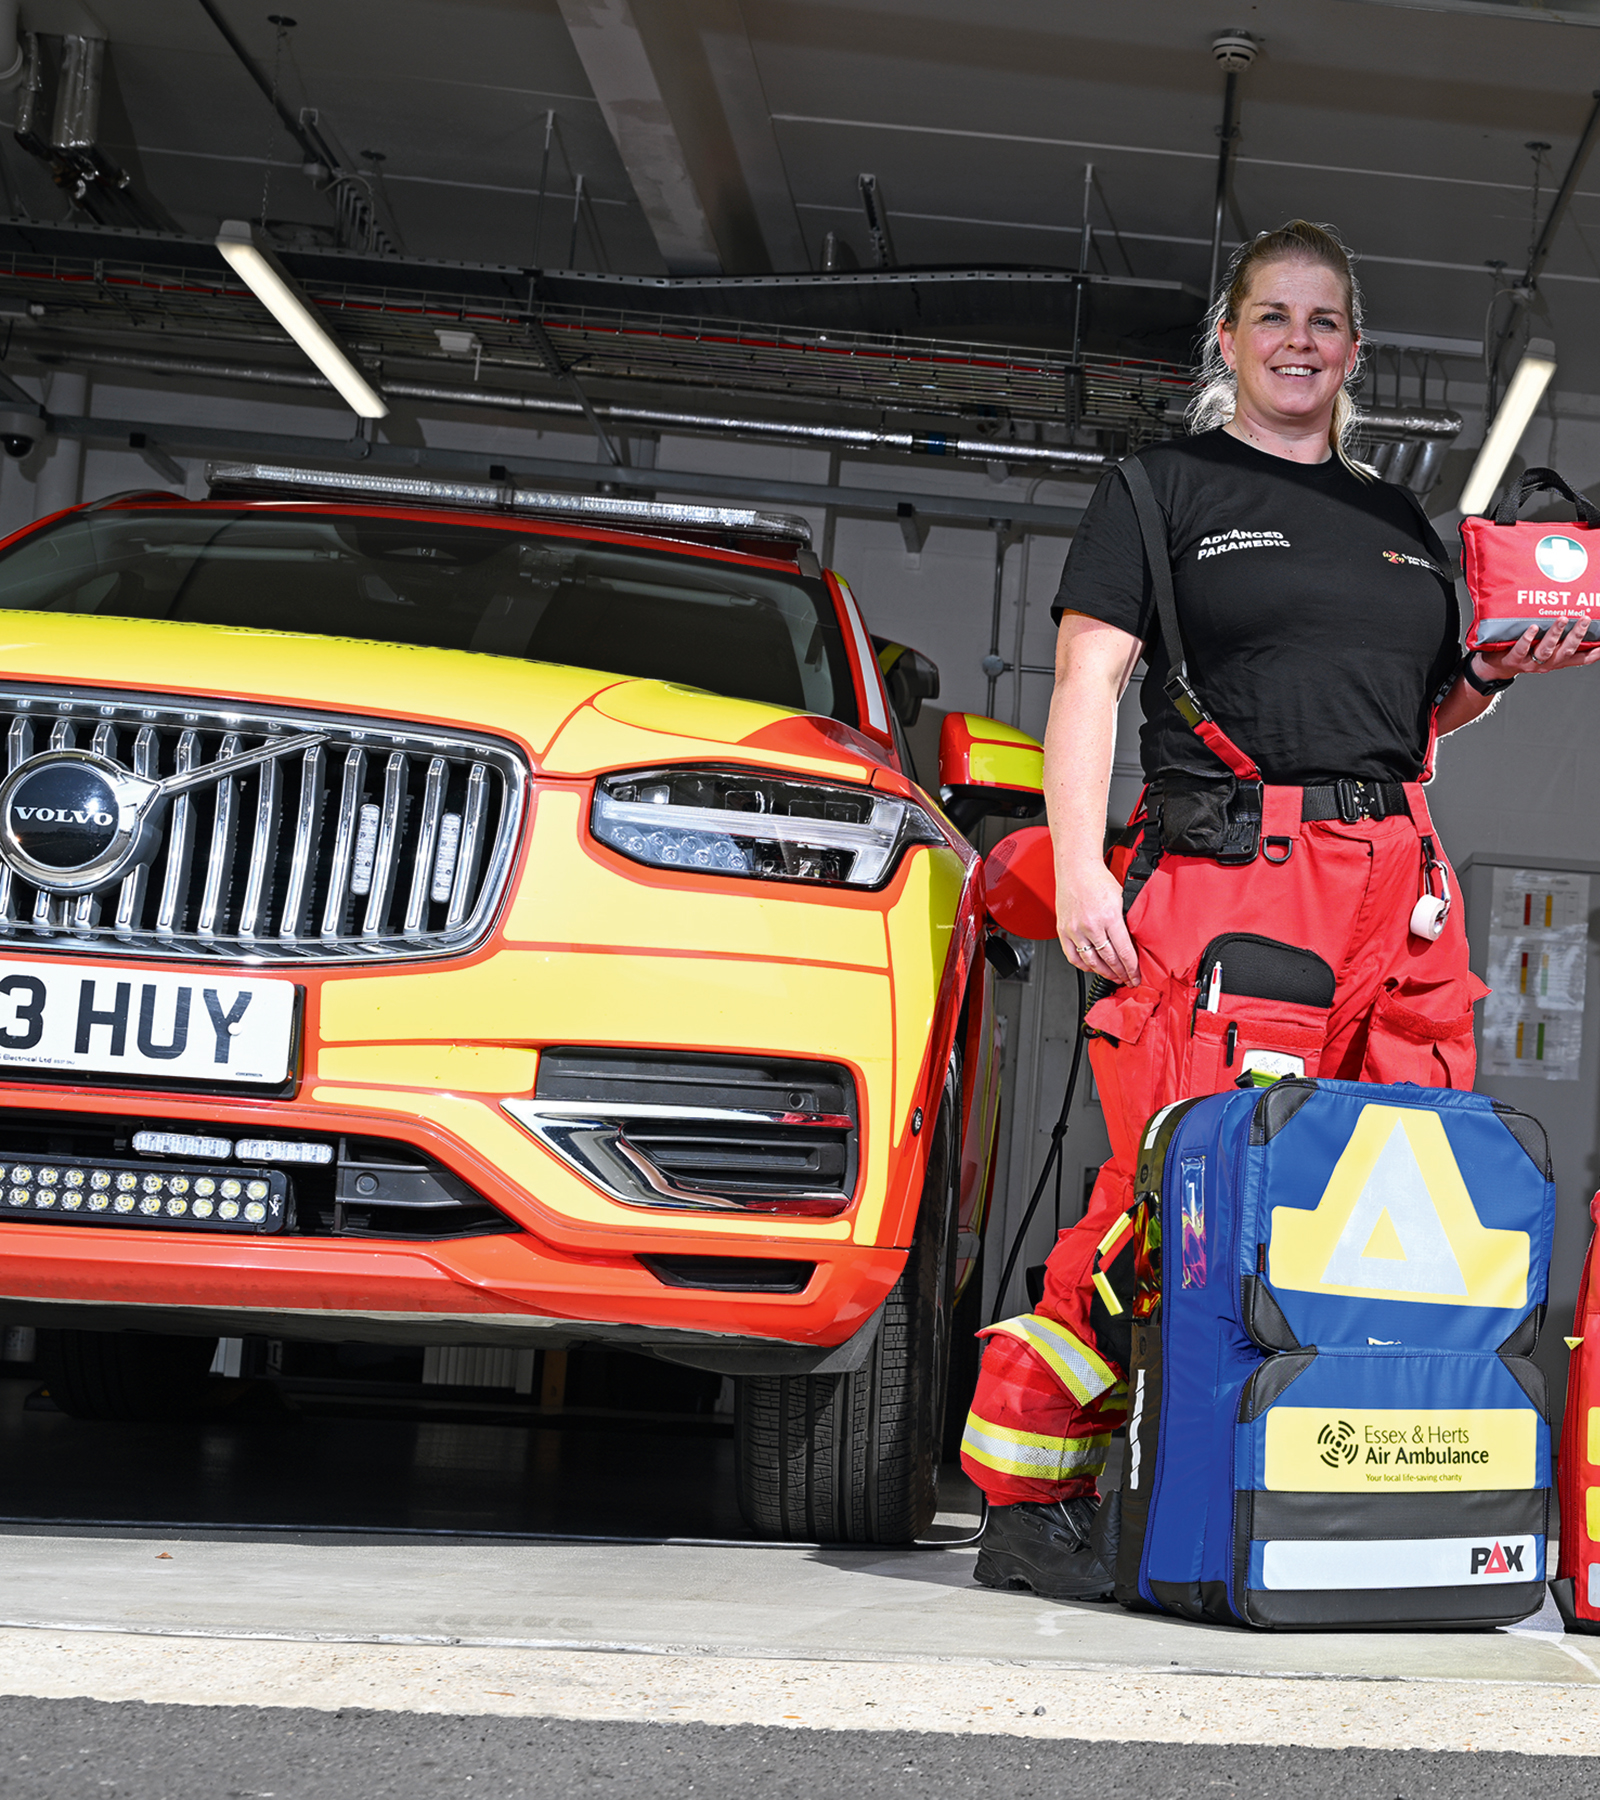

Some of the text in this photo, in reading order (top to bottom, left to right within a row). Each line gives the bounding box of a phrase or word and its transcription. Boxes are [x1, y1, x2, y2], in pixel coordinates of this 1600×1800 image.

[1200, 529, 1284, 546] ADVANCED
[1198, 540, 1291, 560] PARAMEDIC
[1517, 590, 1571, 606] FIRST
[1539, 608, 1567, 616] General
[14, 806, 113, 826] VOLVO
[0, 974, 253, 1064] 3 HUY
[39, 1056, 52, 1064] Ltd
[1365, 1425, 1469, 1444] Essex & Herts
[1365, 1446, 1489, 1465] Air Ambulance
[1366, 1473, 1463, 1484] Your local life-saving charity
[1471, 1541, 1524, 1575] PAX
